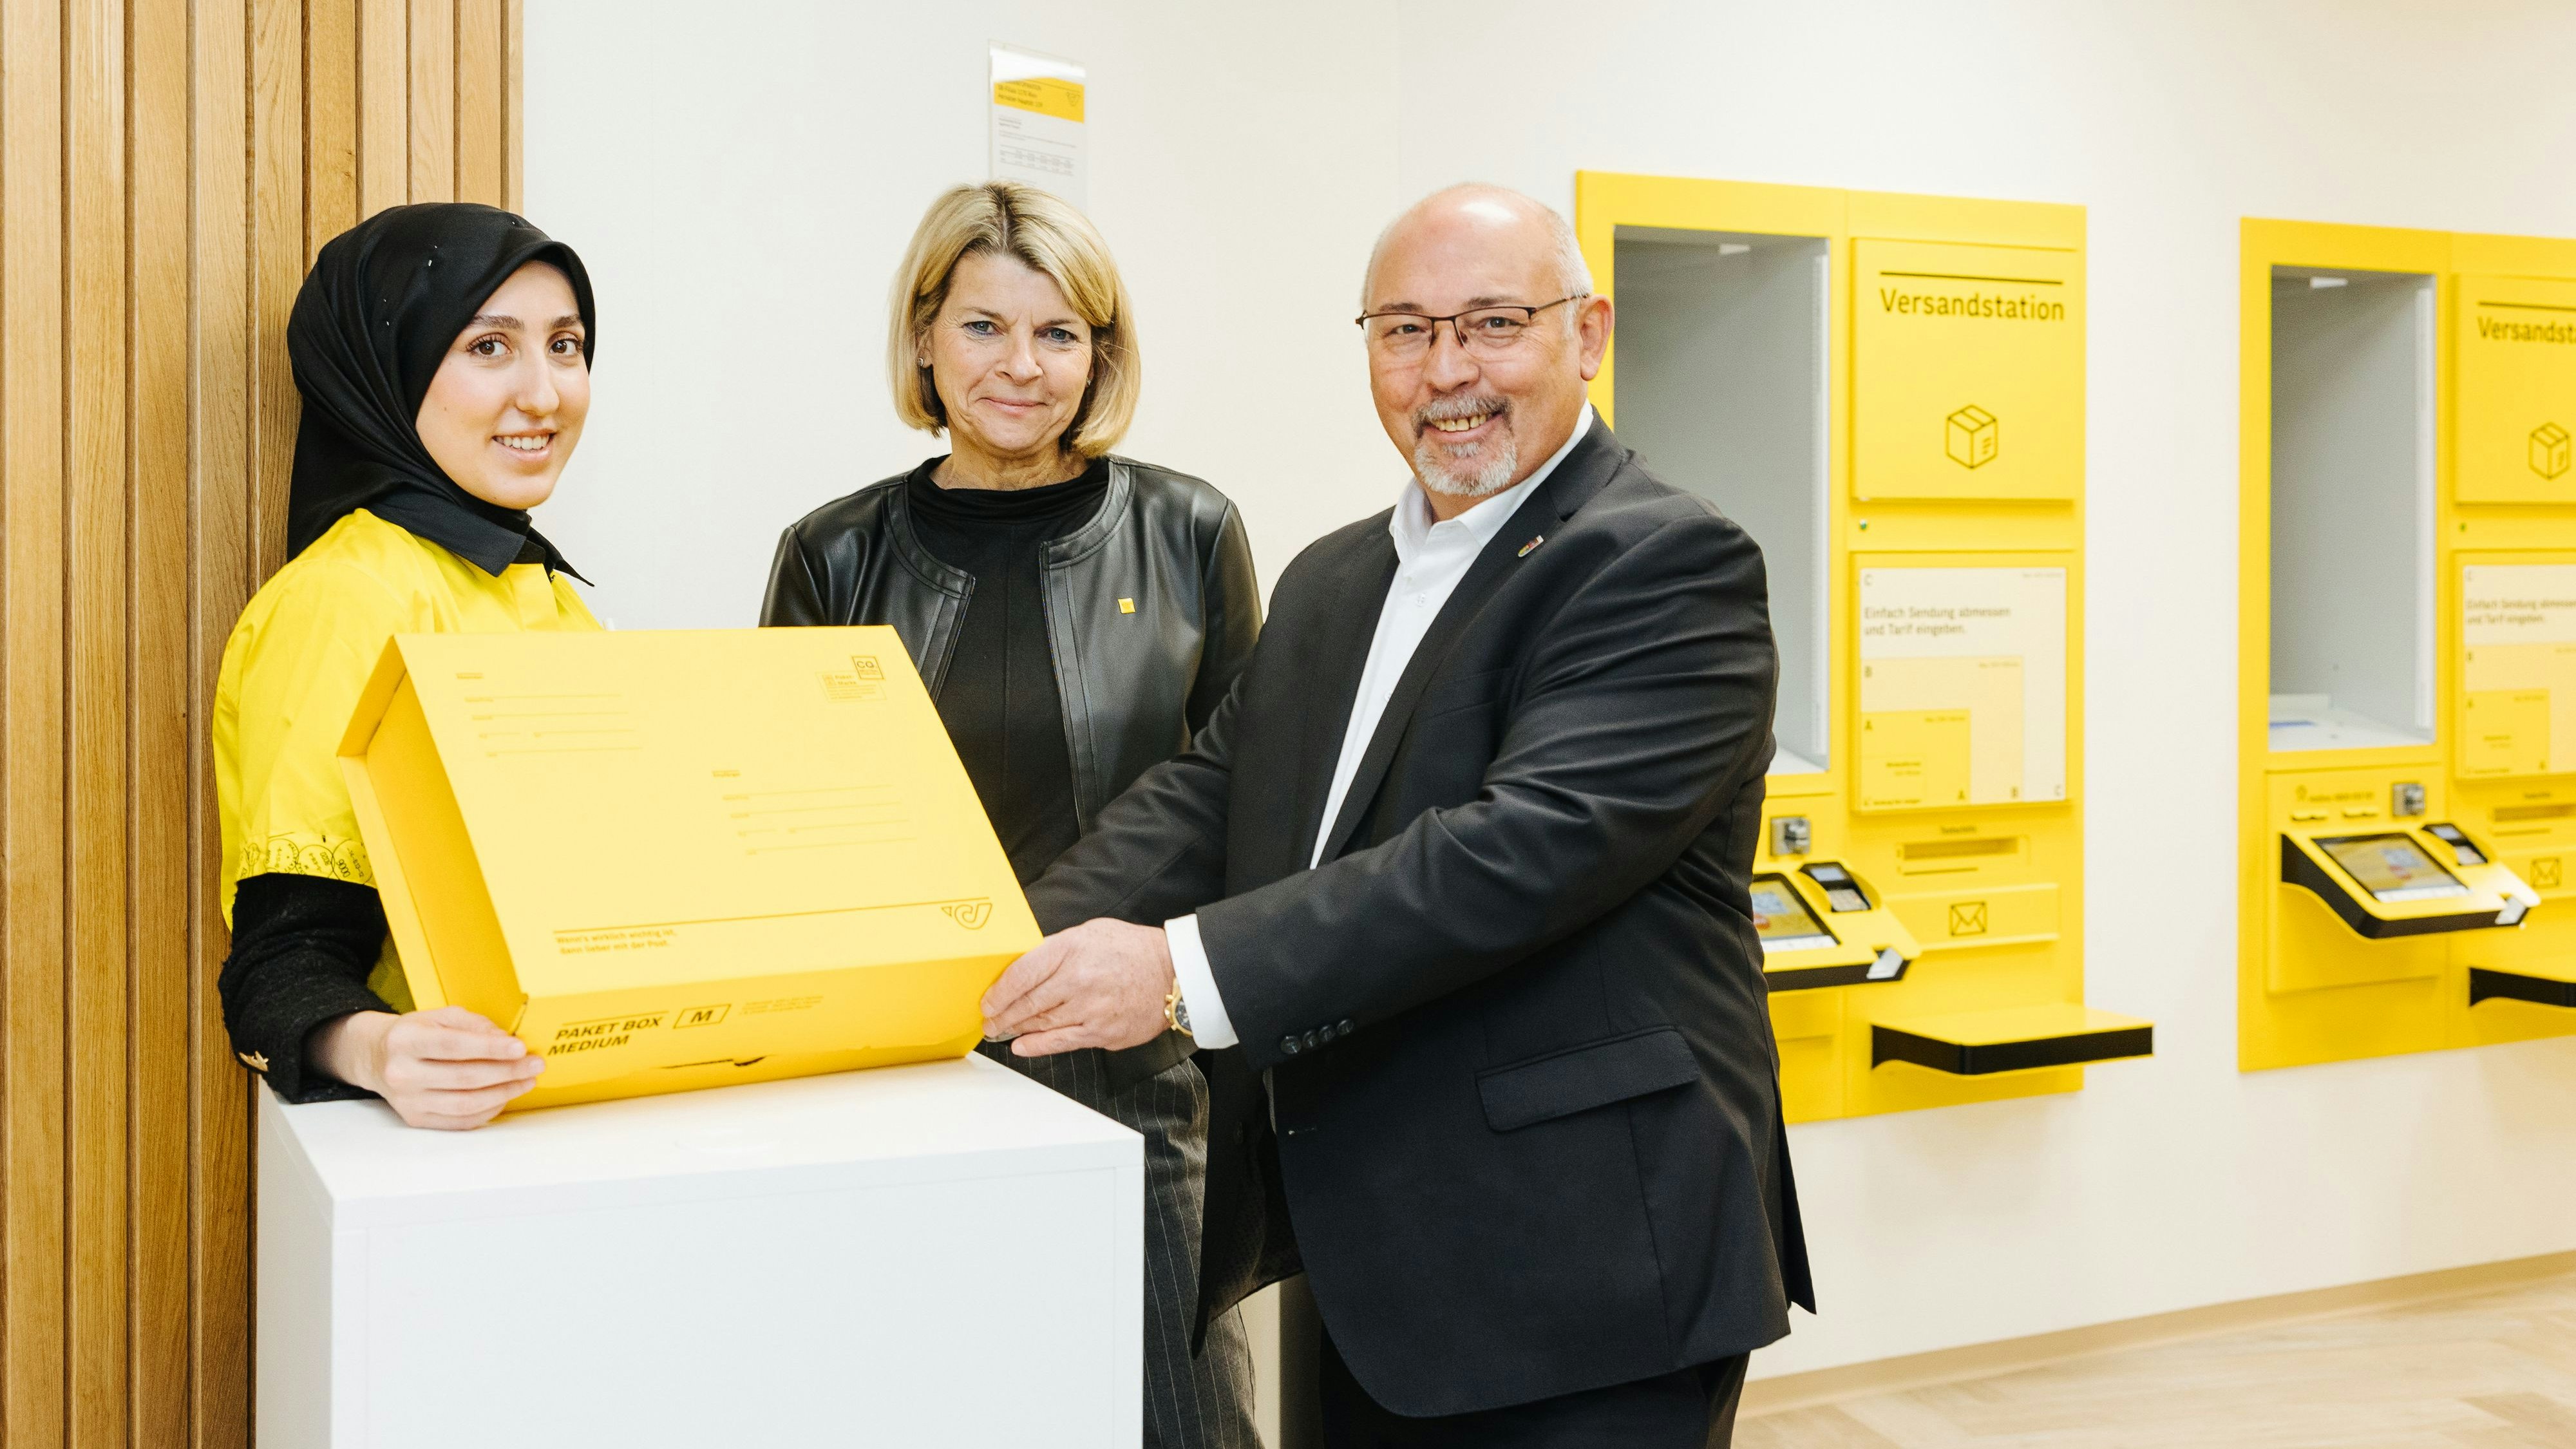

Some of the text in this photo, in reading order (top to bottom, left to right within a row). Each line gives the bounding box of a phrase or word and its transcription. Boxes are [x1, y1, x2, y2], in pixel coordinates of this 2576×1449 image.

[1880, 288, 2065, 321] Versandstation
[1909, 607, 1955, 620] Sendung
[690, 1010, 714, 1023] M
[555, 1016, 663, 1040] PAKET BOX
[547, 1035, 630, 1056] MEDIUM
